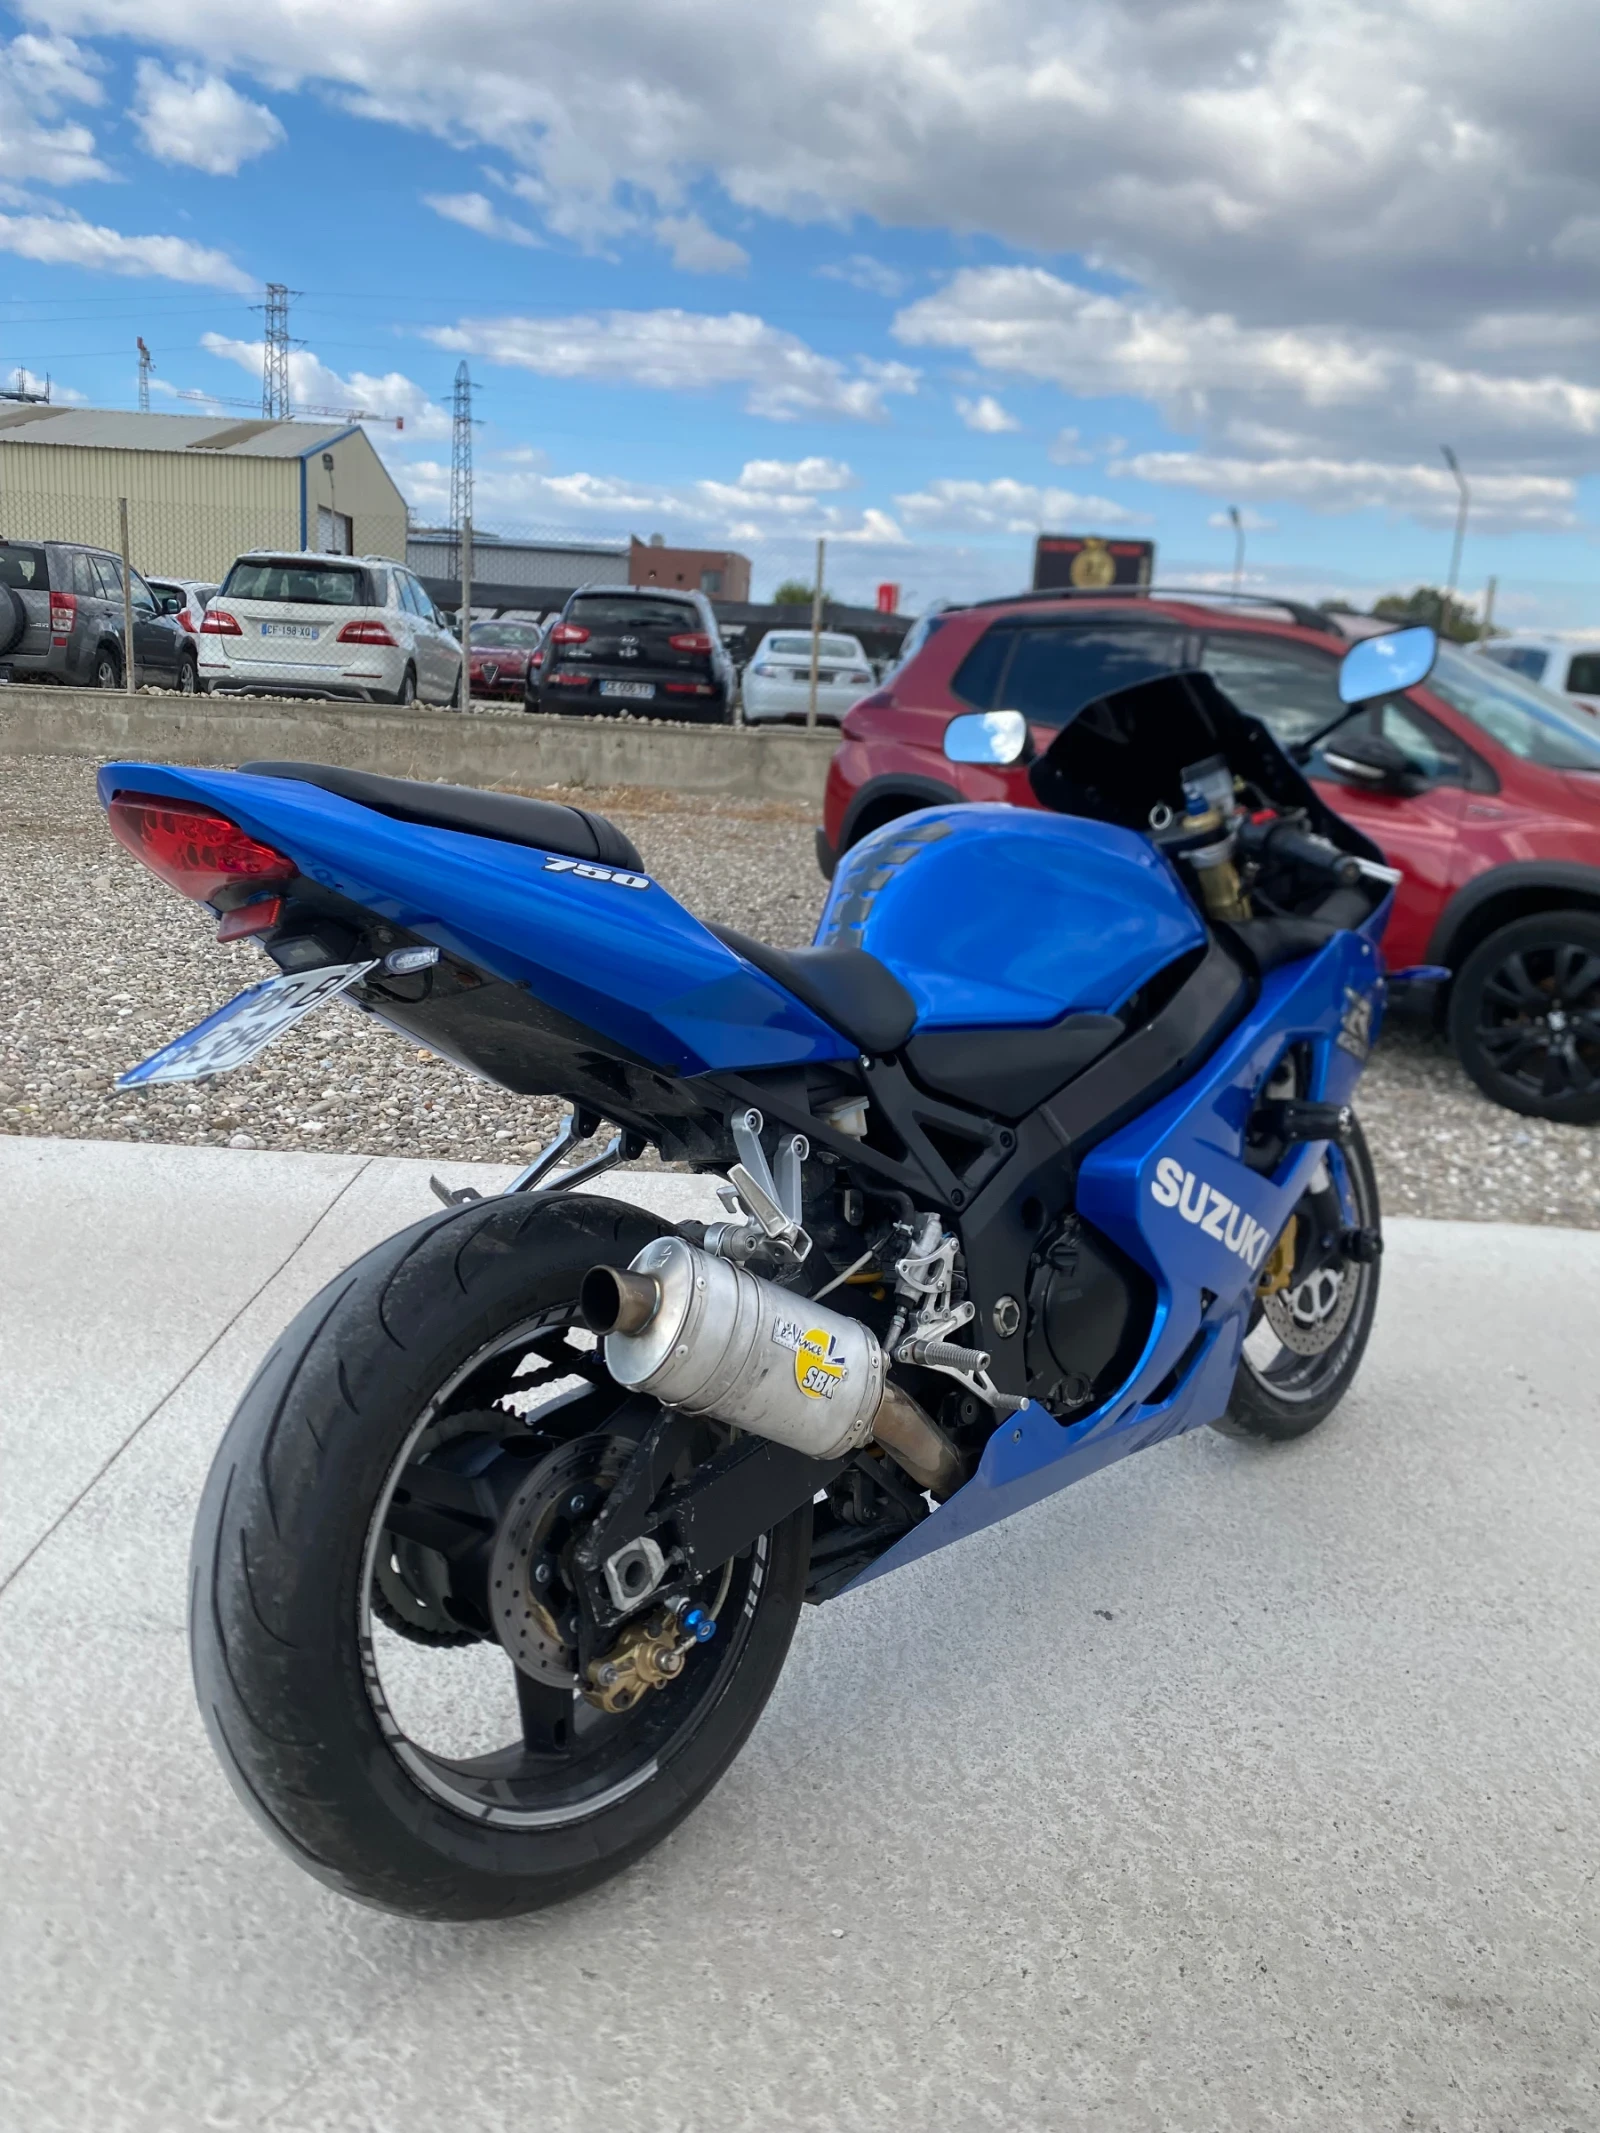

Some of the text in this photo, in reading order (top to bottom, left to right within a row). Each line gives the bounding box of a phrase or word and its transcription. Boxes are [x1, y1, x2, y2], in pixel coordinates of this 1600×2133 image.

[543, 856, 650, 890] 750
[1151, 1157, 1270, 1271] SUZUKI
[803, 1366, 840, 1399] SBK
